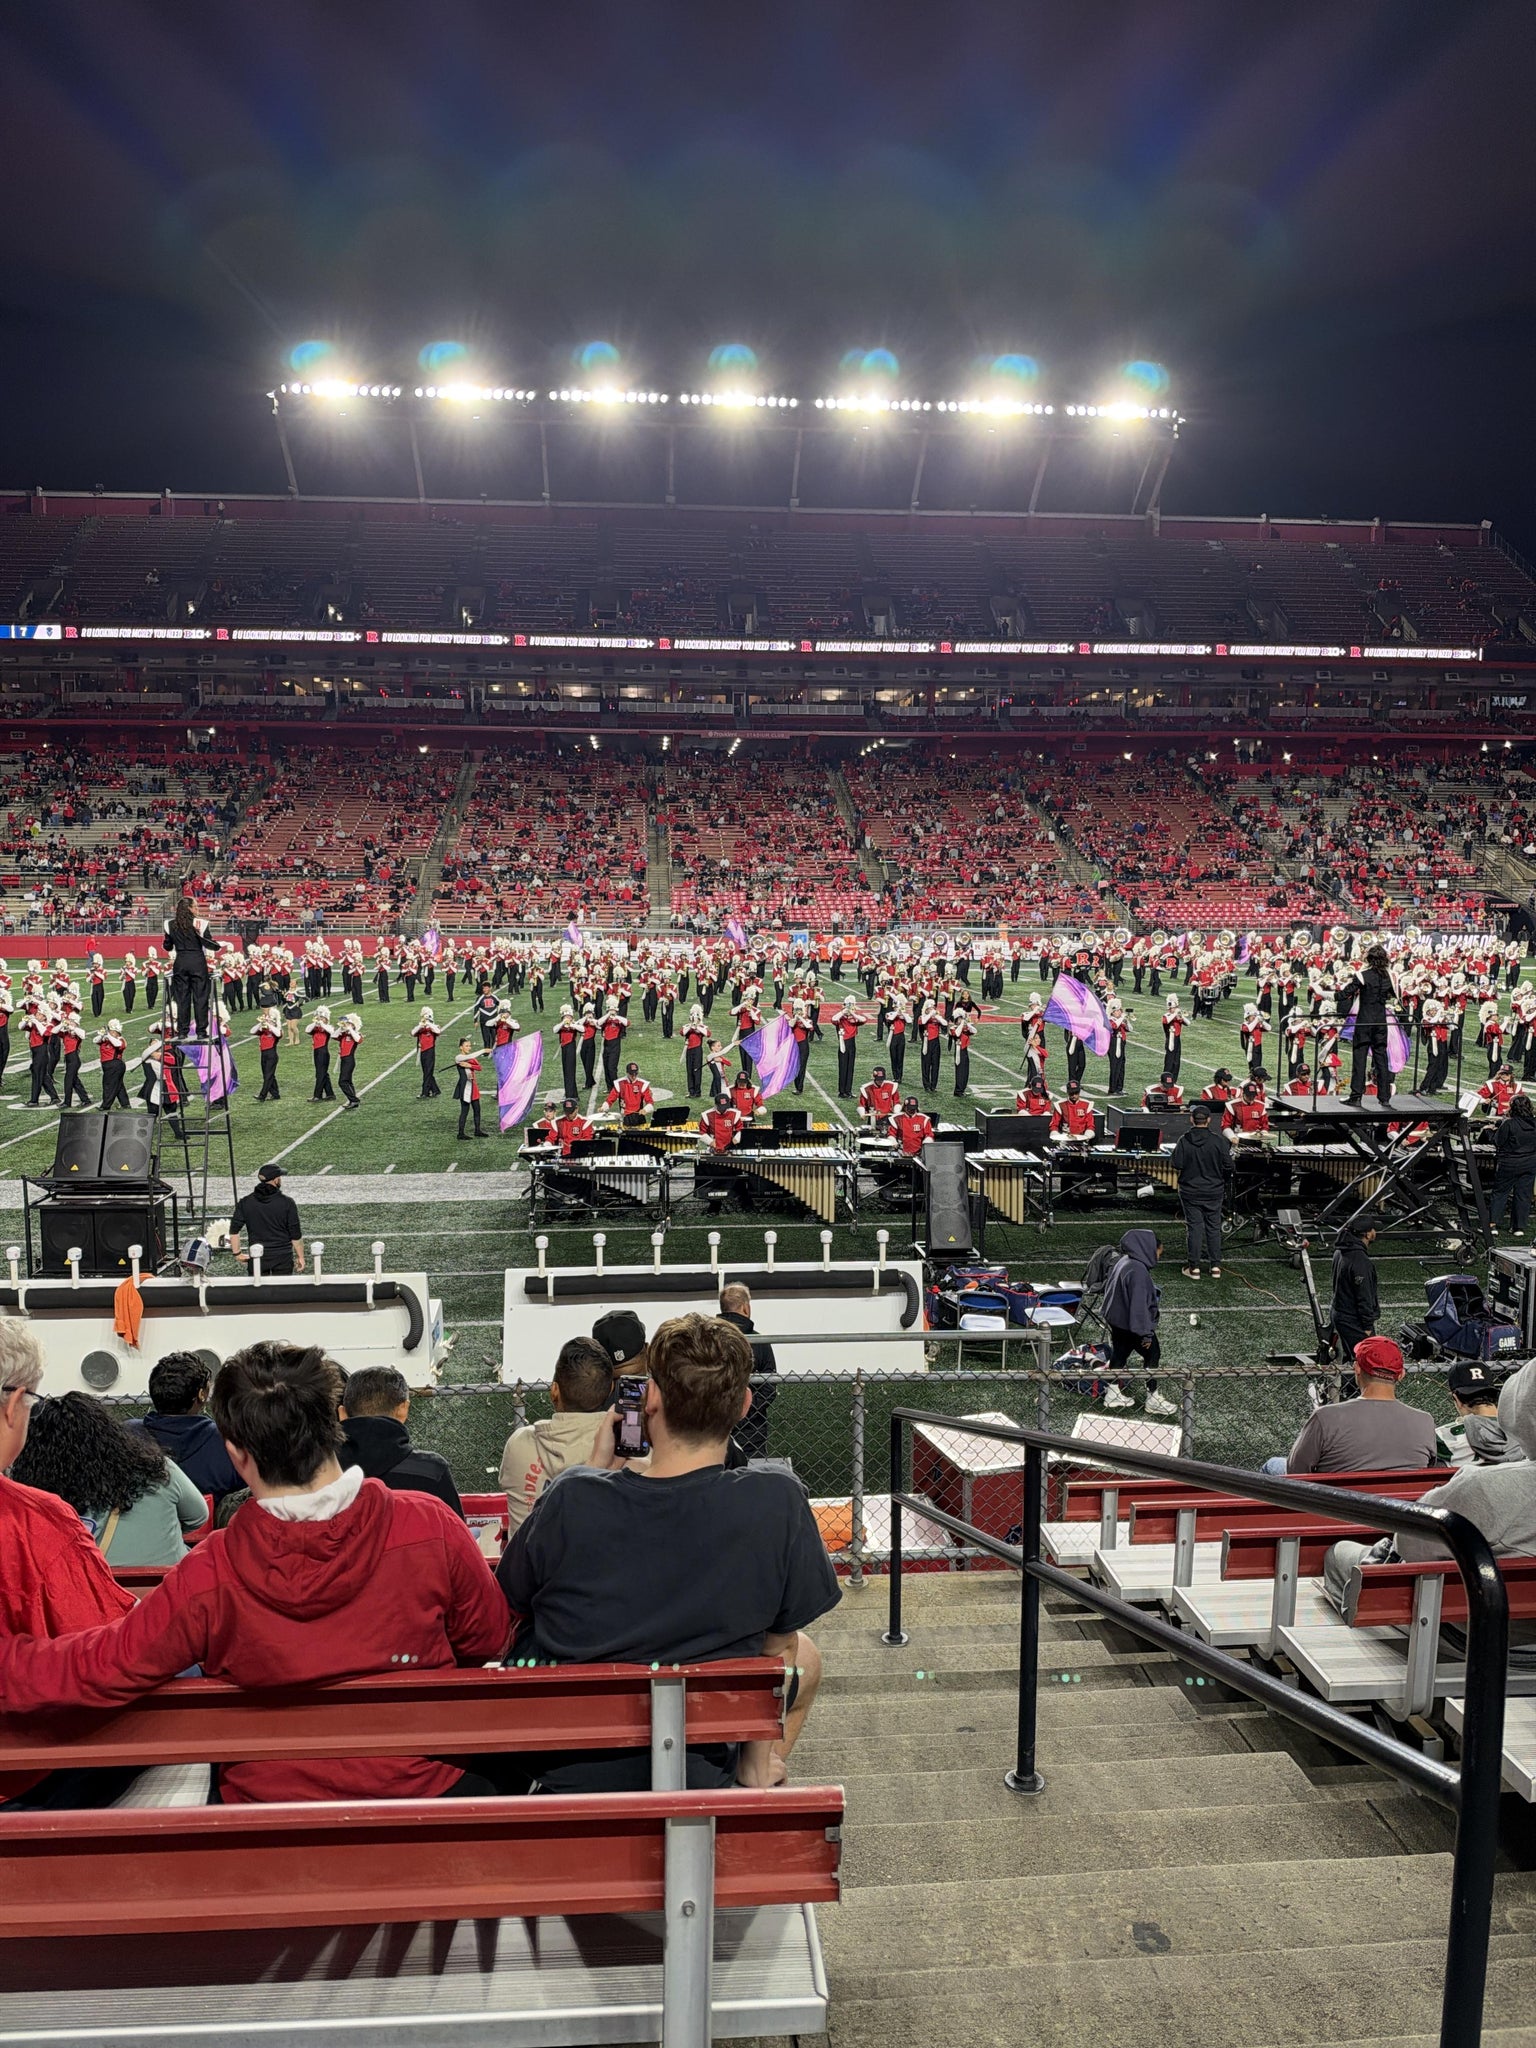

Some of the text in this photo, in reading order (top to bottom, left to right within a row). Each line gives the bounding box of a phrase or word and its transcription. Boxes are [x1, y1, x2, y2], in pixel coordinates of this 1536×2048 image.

[1076, 952, 1091, 966] R
[1165, 957, 1176, 968] R
[1498, 1336, 1516, 1348] GAME
[1469, 1368, 1485, 1381] R
